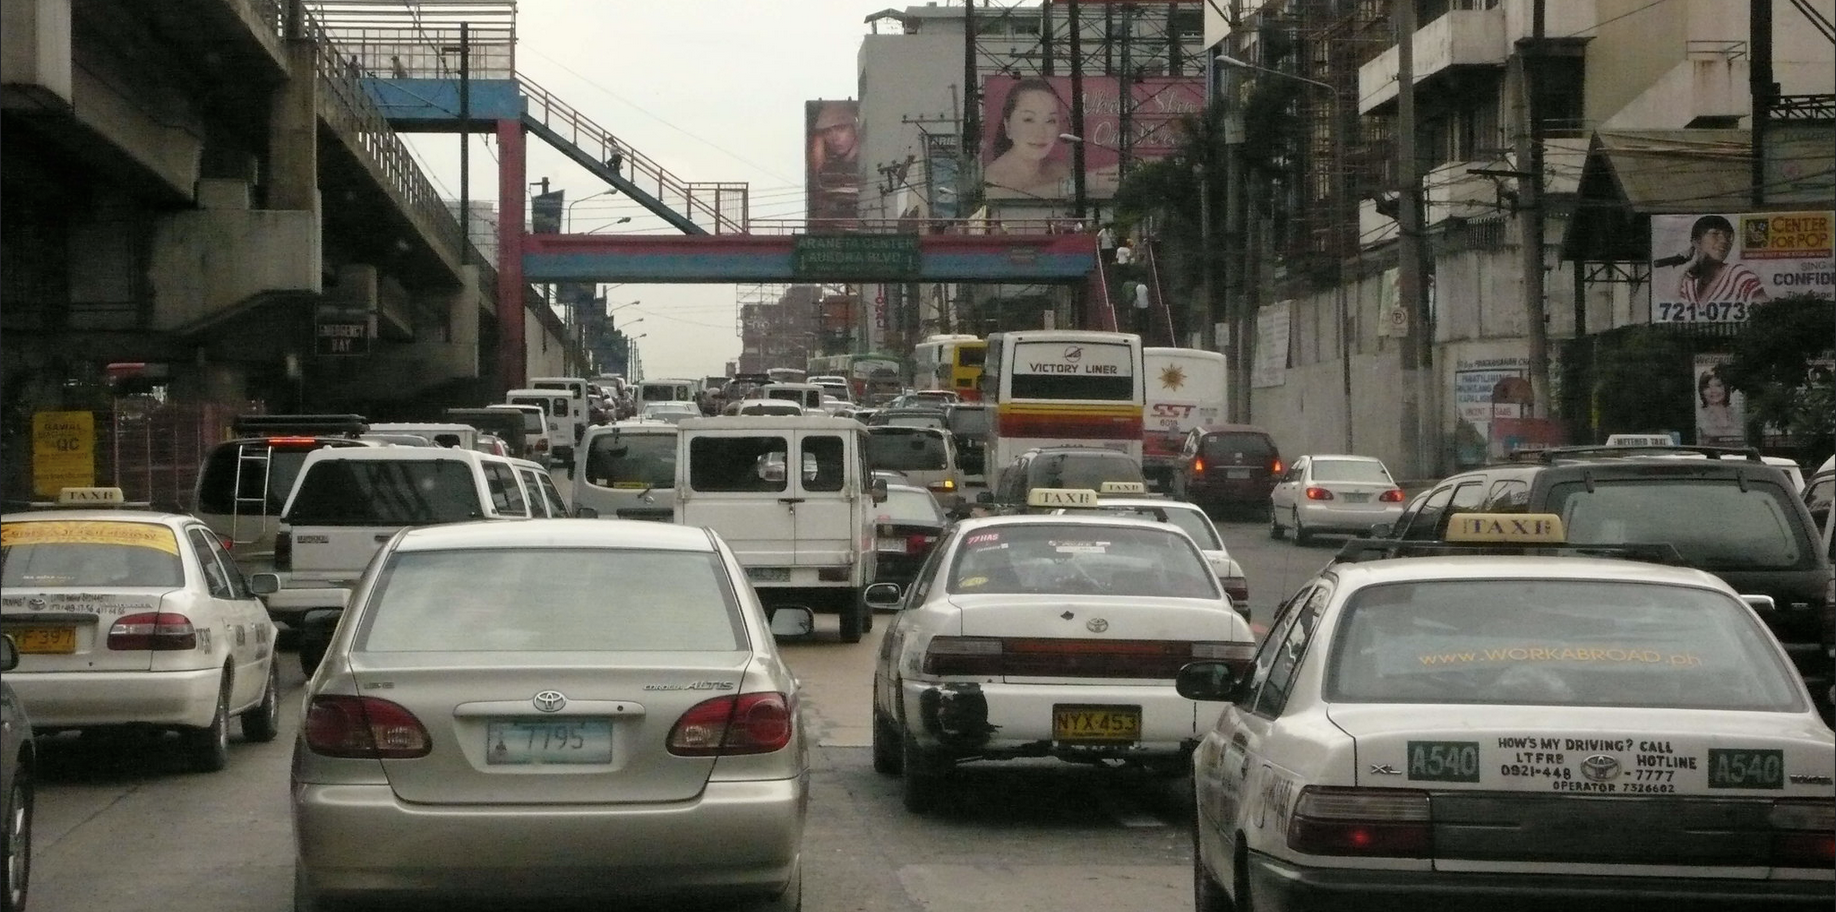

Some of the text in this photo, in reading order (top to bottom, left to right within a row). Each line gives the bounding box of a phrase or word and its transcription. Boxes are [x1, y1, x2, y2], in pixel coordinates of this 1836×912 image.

[1770, 216, 1828, 233] CENTER
[798, 238, 913, 250] ARANETA CENTER
[1771, 232, 1828, 248] FOR POP
[809, 252, 864, 264] AURORA
[1800, 262, 1828, 272] SING
[319, 324, 364, 338] EMERGENCY
[332, 338, 351, 352] BAY
[1029, 362, 1118, 375] VICTORY LINER
[1151, 403, 1197, 419] SST
[1650, 437, 1667, 446] TAXI
[70, 491, 108, 500] TAXI
[1041, 492, 1087, 505] TAXI
[1468, 518, 1544, 535] TAXI
[684, 680, 735, 691] ALTIS
[524, 724, 584, 750] 7795
[1497, 737, 1673, 754] HOW'S MY DRIVING? CALL
[1411, 744, 1478, 777] A540
[1515, 752, 1698, 770] LTFRB HOTLINE
[1370, 763, 1402, 775] XL
[1713, 753, 1781, 784] A540
[1552, 782, 1616, 793] OPERATOR
